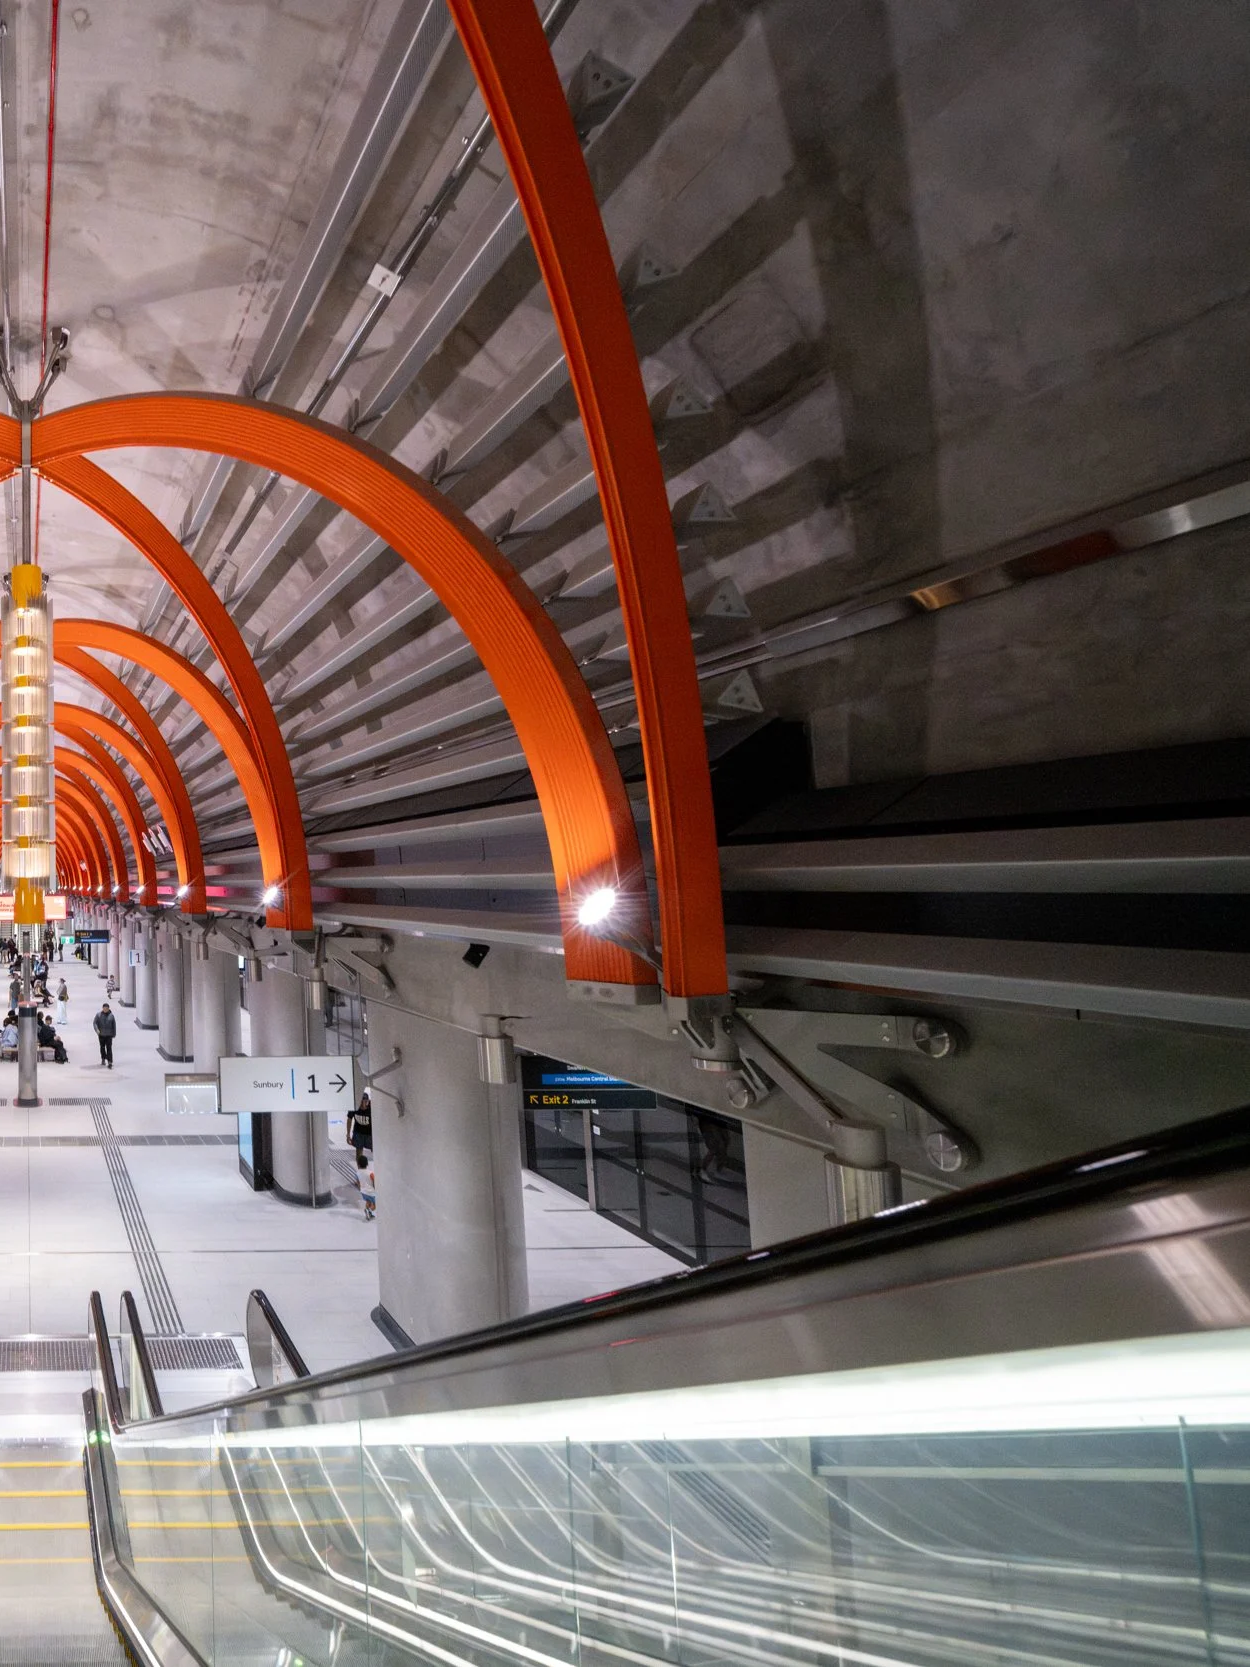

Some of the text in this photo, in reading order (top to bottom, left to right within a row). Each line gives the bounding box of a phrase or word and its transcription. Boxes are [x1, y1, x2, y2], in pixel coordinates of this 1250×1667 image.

[135, 953, 141, 963] 1
[253, 1080, 284, 1090] Sunbury
[307, 1074, 320, 1093] 1
[542, 1095, 569, 1105] Exit 2
